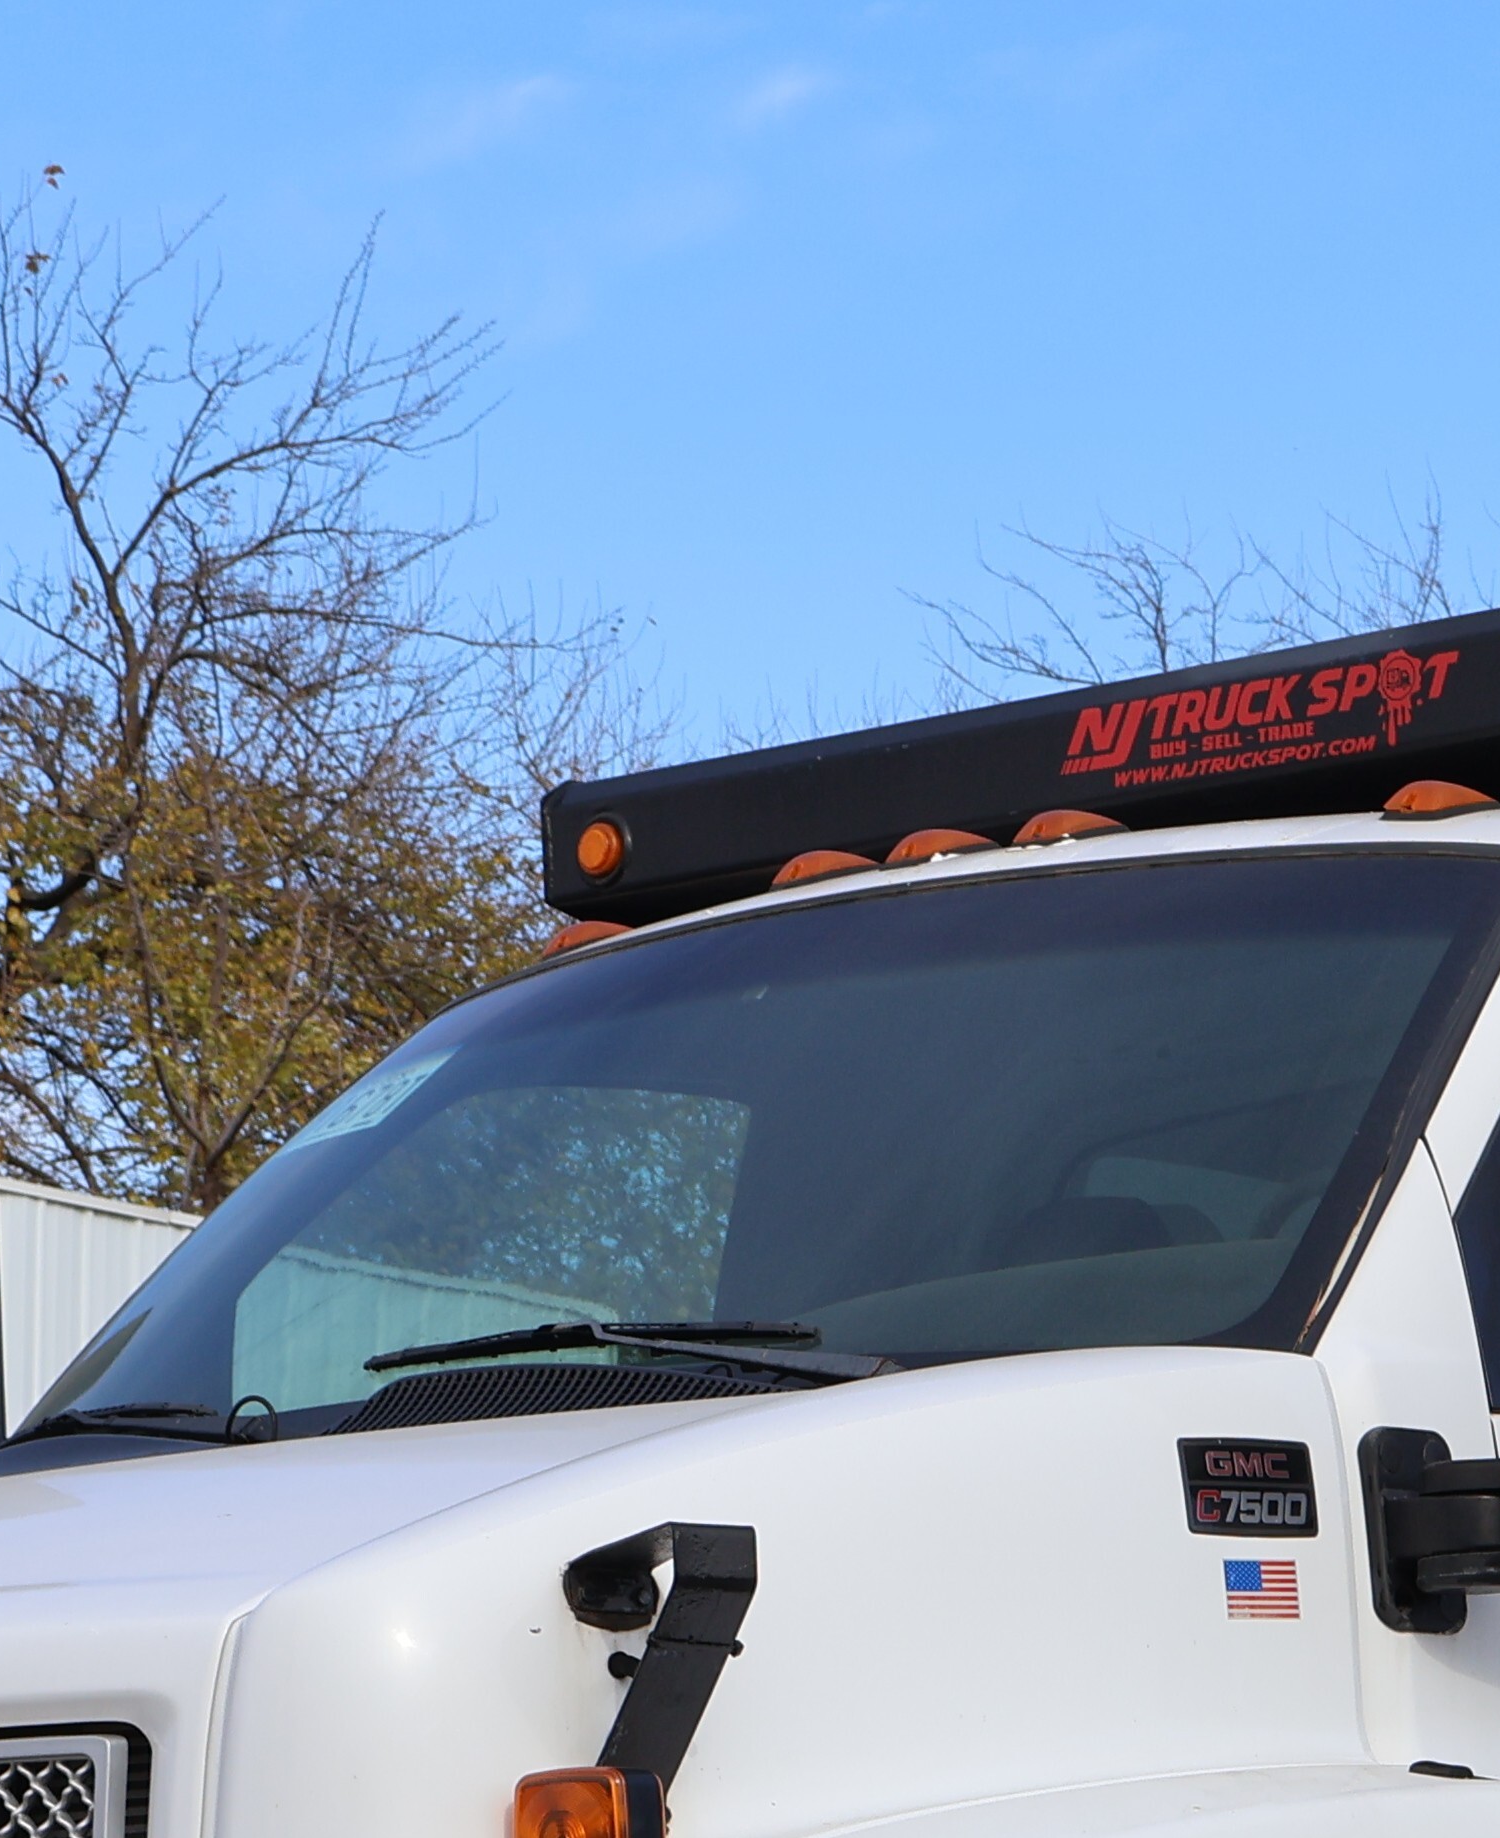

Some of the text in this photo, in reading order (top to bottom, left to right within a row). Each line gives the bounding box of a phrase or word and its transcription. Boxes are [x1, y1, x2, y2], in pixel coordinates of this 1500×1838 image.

[1149, 740, 1187, 760] BUY
[1201, 731, 1243, 752] SELL
[1257, 721, 1315, 743] TRADE
[1114, 736, 1376, 788] WWW.NJTRUCKSPOT.COM
[1204, 1450, 1290, 1479] GMC
[1196, 1489, 1308, 1525] C7500
